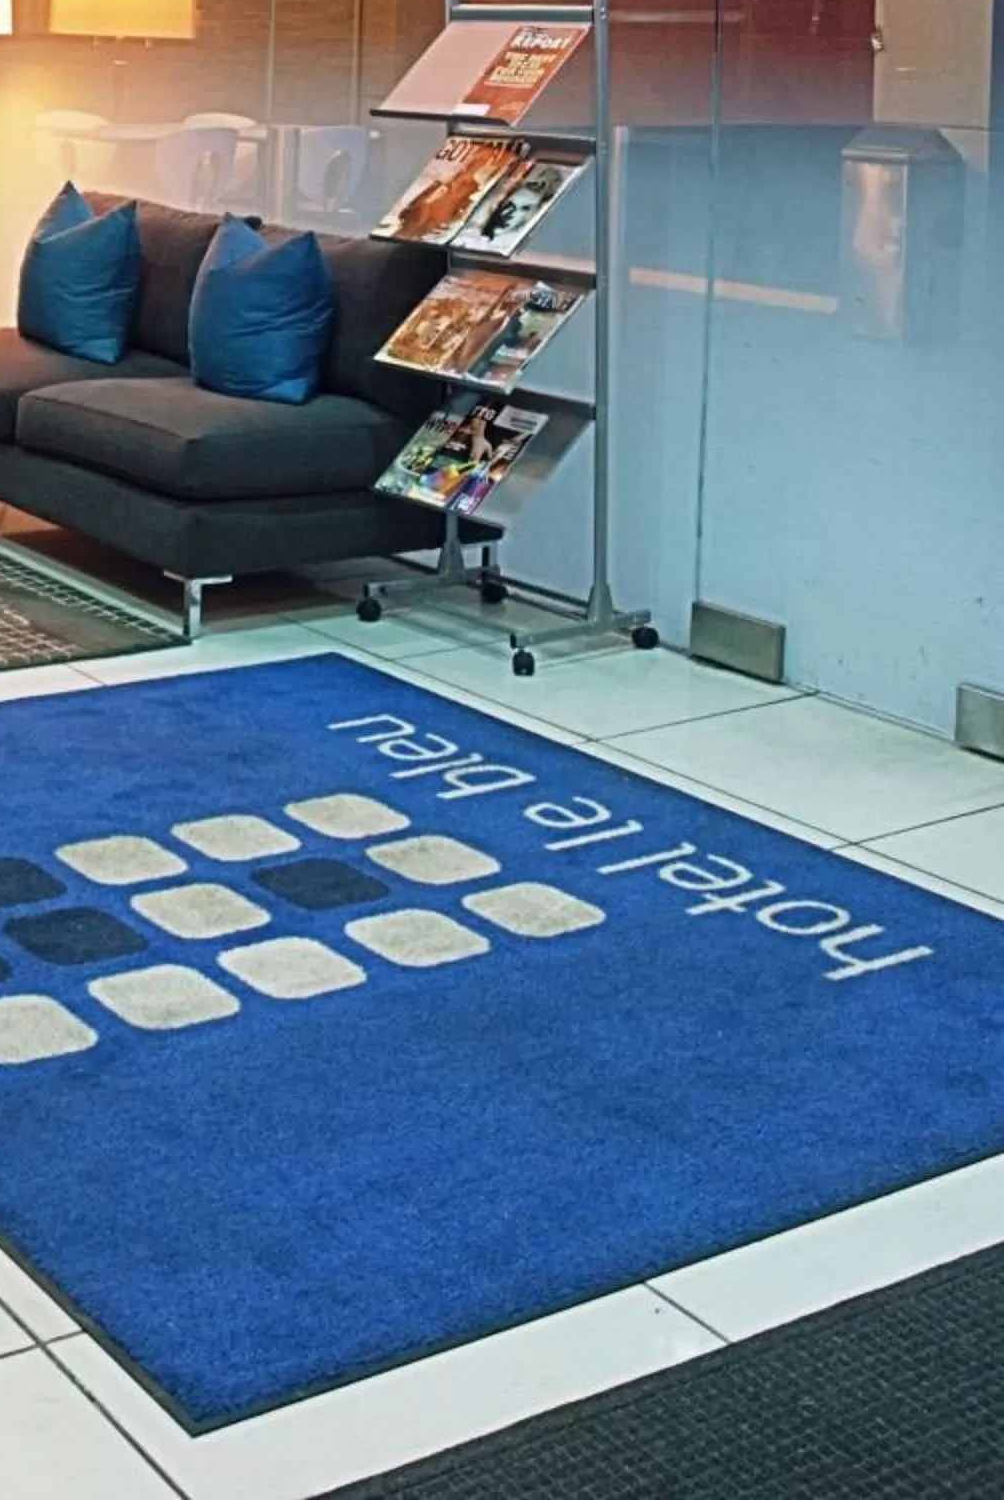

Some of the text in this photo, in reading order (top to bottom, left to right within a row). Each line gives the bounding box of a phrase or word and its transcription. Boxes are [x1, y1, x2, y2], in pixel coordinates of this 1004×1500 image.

[327, 714, 934, 981] hotel le bleu
